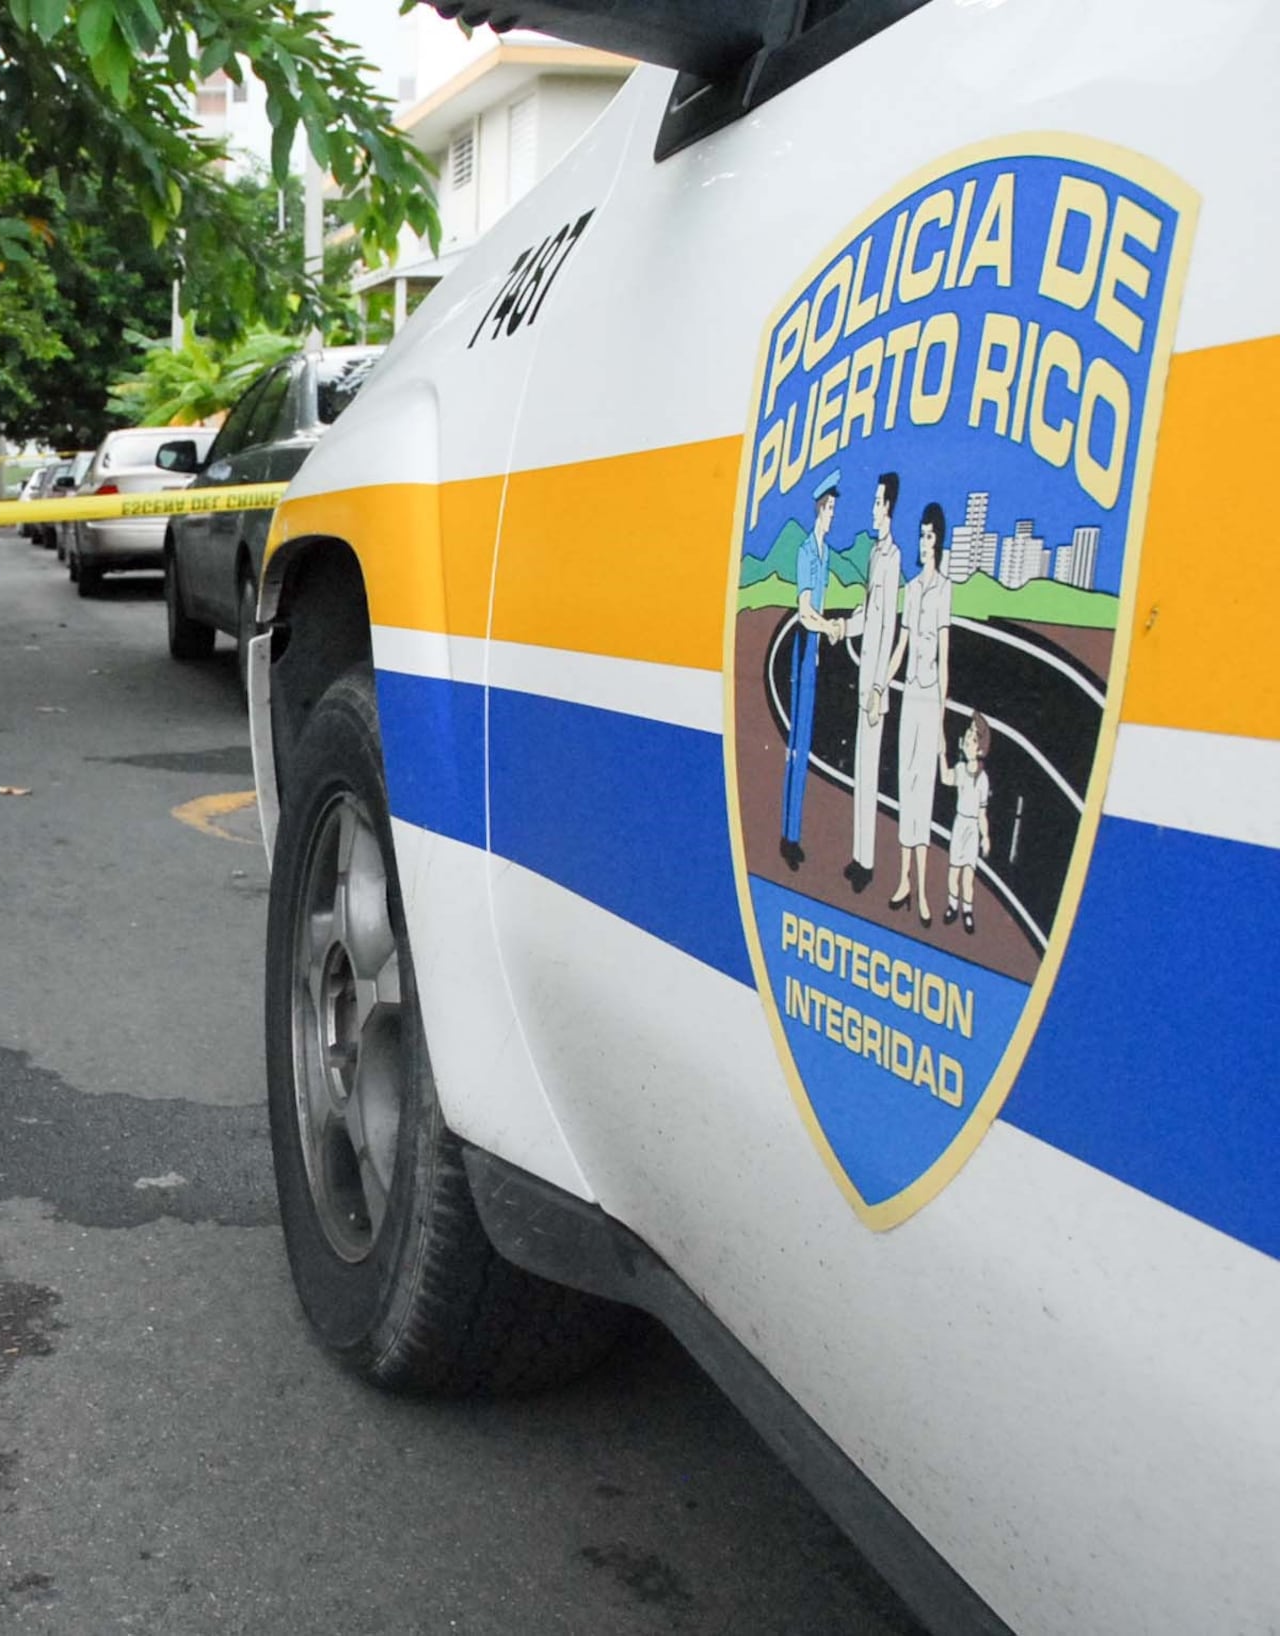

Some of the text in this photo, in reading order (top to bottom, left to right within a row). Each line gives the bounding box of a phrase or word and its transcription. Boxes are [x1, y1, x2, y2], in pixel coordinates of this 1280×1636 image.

[467, 207, 596, 349] 7487
[765, 172, 1163, 421] POLICIA DE
[749, 311, 1131, 532] PUERTO RICO
[781, 911, 974, 1039] PROTECCION
[785, 975, 965, 1109] INTEGRIDAD
